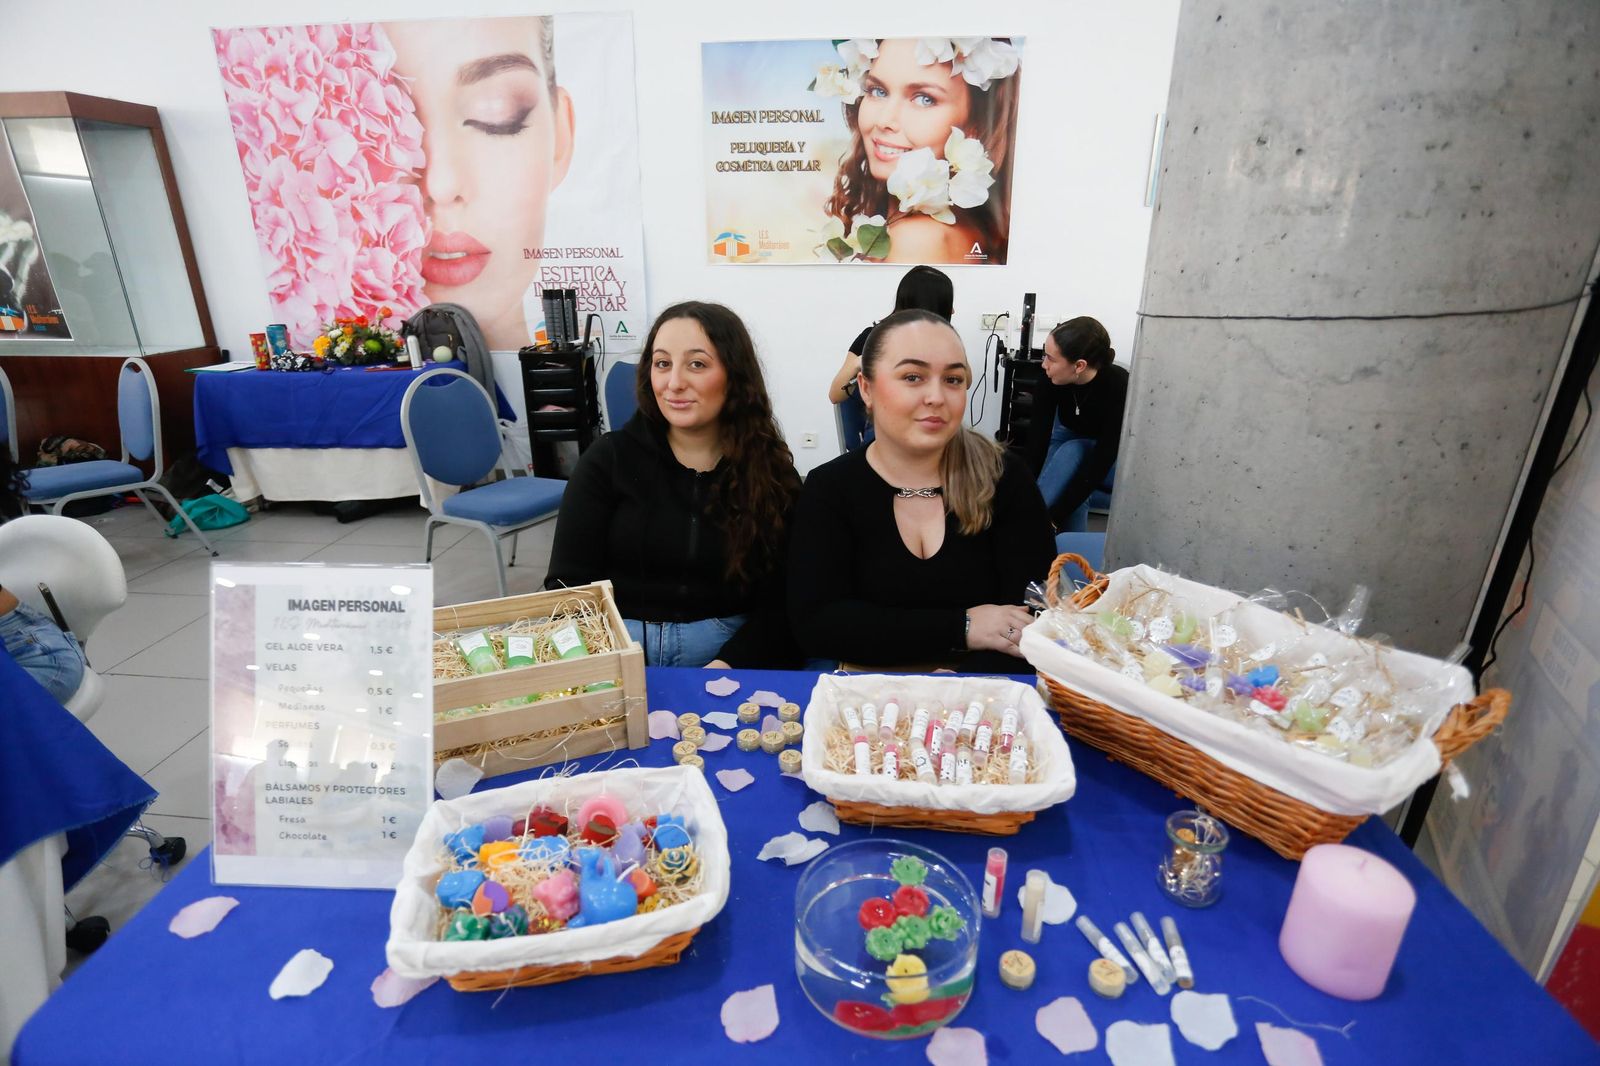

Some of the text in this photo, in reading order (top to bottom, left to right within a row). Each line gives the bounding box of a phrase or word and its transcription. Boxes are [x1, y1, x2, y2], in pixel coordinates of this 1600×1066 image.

[711, 109, 824, 124] IMAGEN PERSONAL
[730, 140, 806, 155] PELUQUERÍA Y
[776, 159, 821, 171] CAPILAR
[523, 247, 624, 259] IMAGEN PERSONAL
[616, 280, 627, 297] Y
[288, 599, 406, 613] IMAGEN PERSONAL
[265, 642, 344, 652] GEL ALOE VERA
[370, 646, 393, 655] 1,5 €
[265, 663, 297, 672] VELAS
[367, 687, 393, 697] 0,5 €
[385, 706, 393, 715] €
[265, 721, 320, 730] PERFUMES
[324, 785, 330, 793] Y
[332, 785, 406, 796] PROTECTORES
[265, 796, 314, 805] LABIALES
[279, 815, 306, 824] Fresa
[388, 816, 396, 824] €
[279, 831, 328, 841] Chocolate
[389, 831, 396, 839] €
